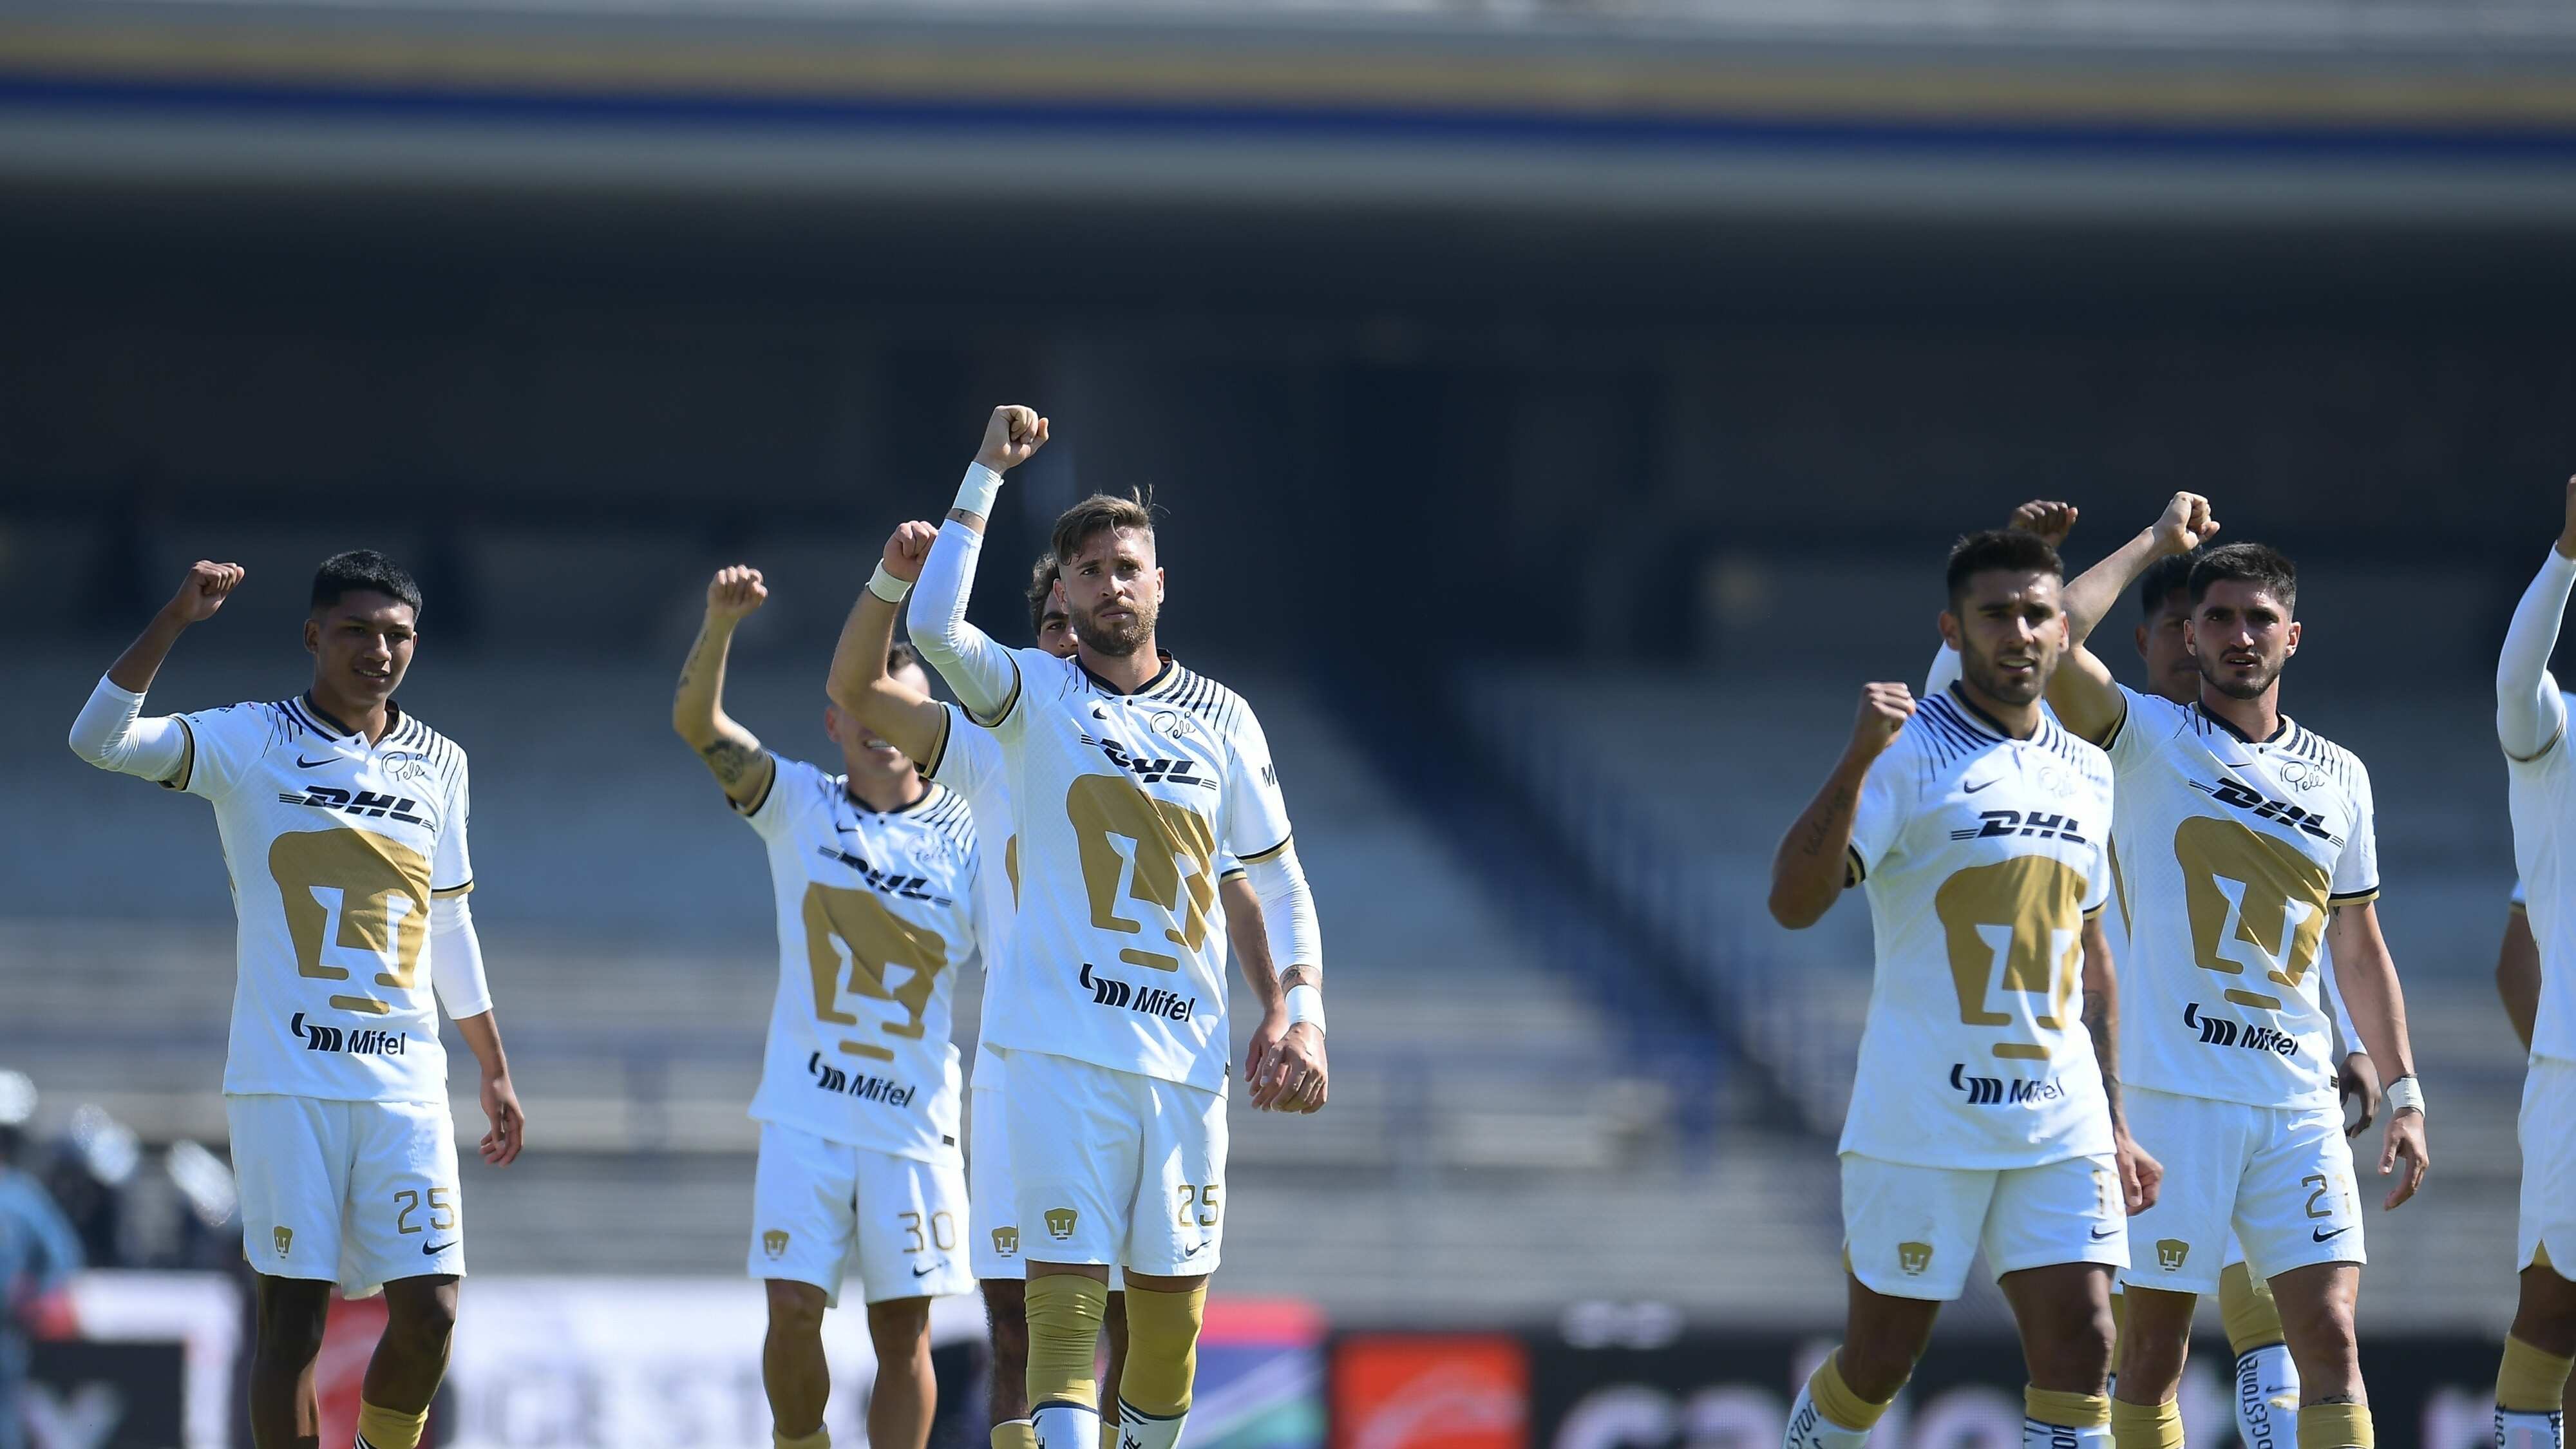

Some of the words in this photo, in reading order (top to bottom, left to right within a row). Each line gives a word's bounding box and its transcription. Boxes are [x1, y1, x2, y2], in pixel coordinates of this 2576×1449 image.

[1099, 738, 1201, 785] DHL
[301, 785, 422, 825] DHL
[2211, 777, 2331, 840] DHL
[1977, 810, 2086, 844] DHL
[1132, 987, 1196, 1022] Mifel
[347, 1030, 406, 1055] Mifel
[2240, 1024, 2298, 1056] Mifel
[849, 1074, 916, 1108] Mifel
[2009, 1077, 2065, 1103] Miel
[394, 1188, 455, 1235] 25
[1178, 1184, 1219, 1227] 25
[898, 1212, 956, 1253] 30
